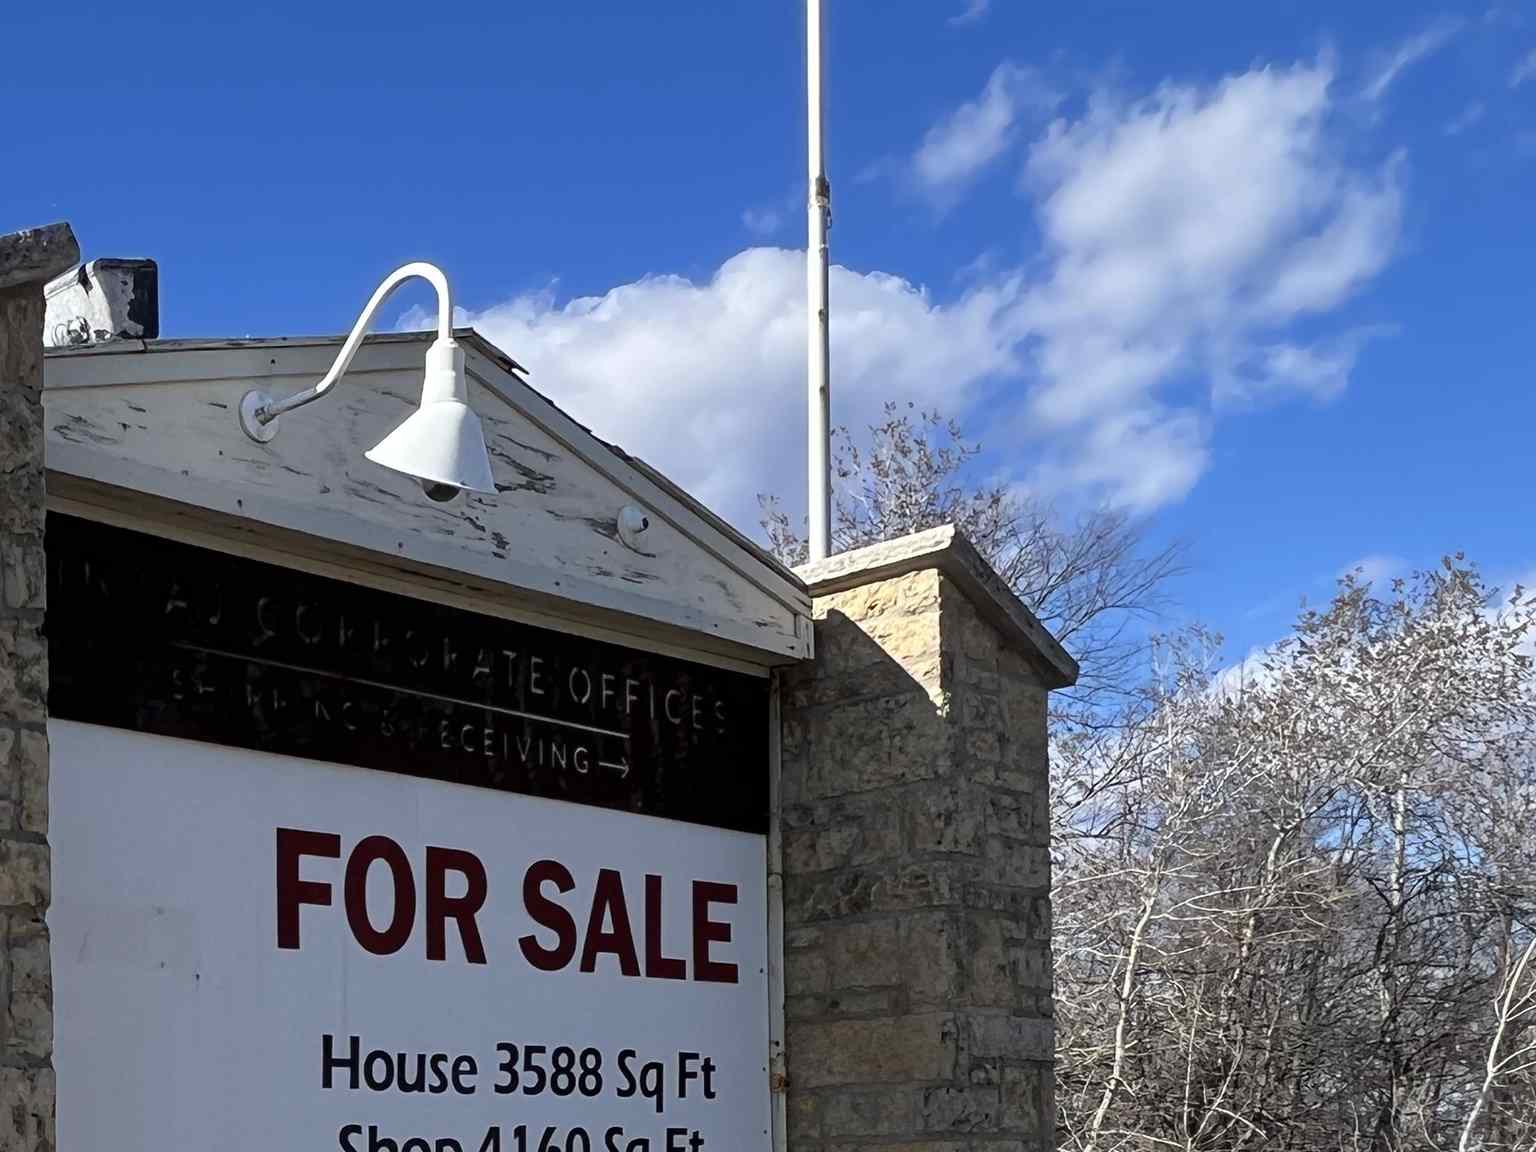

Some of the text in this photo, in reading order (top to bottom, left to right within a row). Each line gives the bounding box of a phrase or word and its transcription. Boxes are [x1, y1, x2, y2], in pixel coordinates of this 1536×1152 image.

[568, 665, 729, 736] OFFICES
[415, 714, 590, 774] ECEIVING
[276, 826, 740, 985] FOR SALE
[321, 1033, 717, 1114] House 3588 Sq Ft
